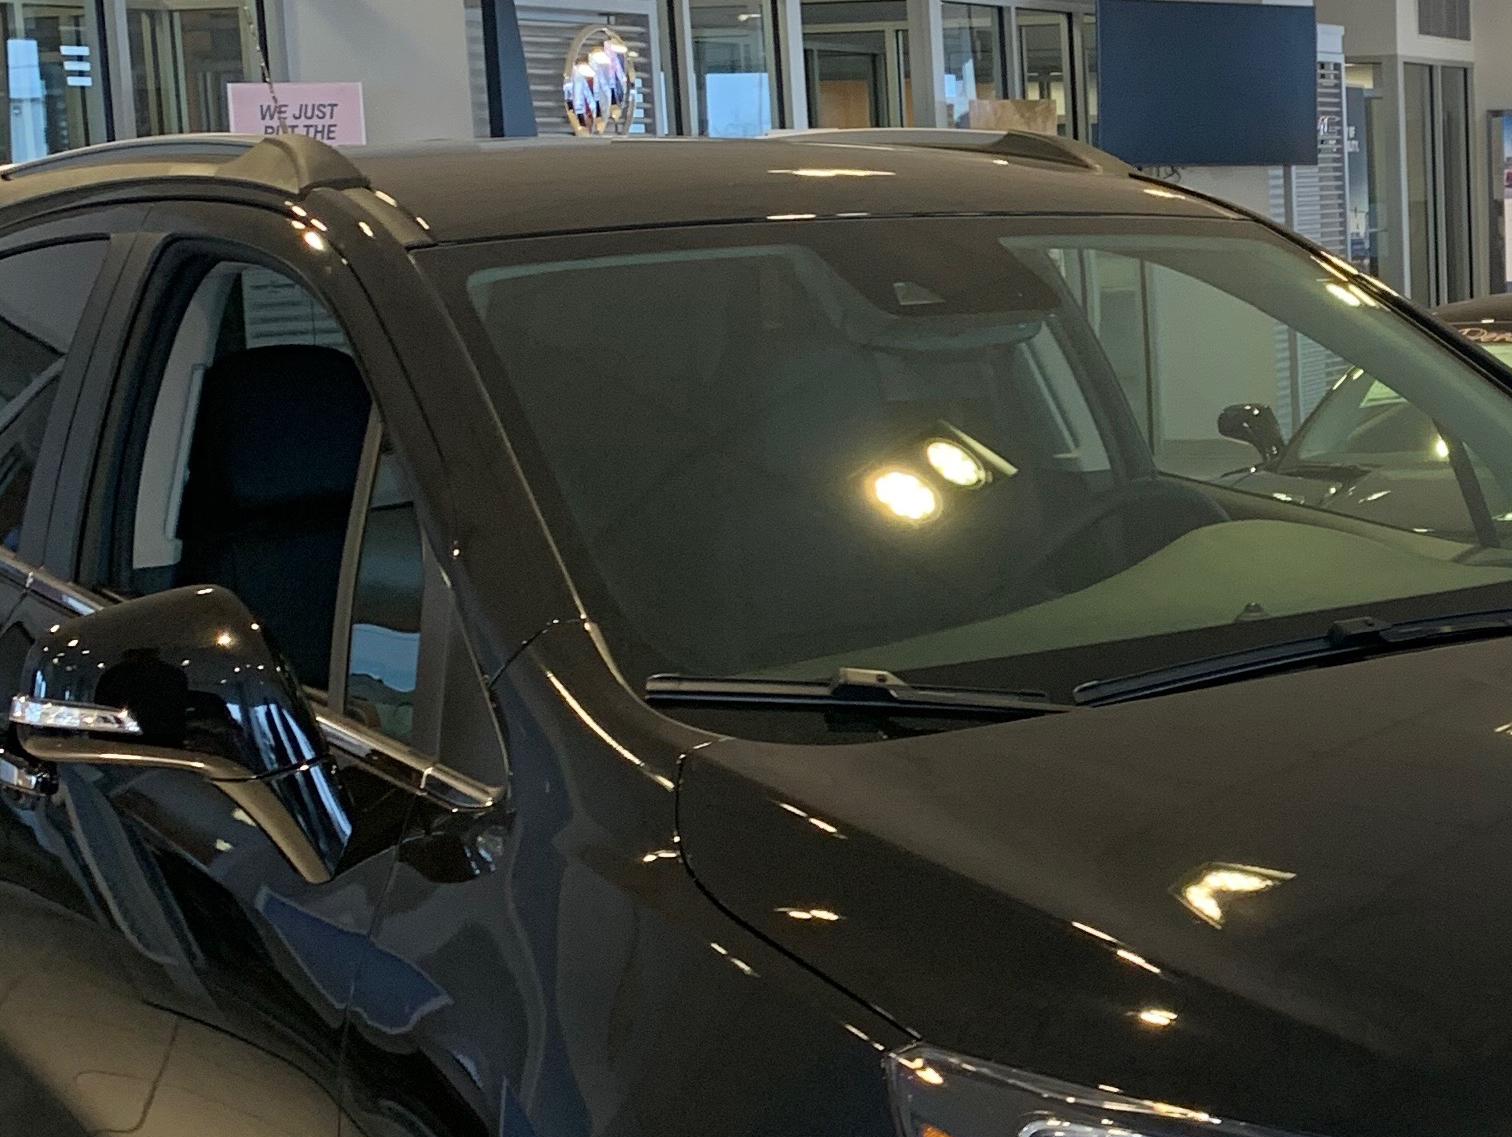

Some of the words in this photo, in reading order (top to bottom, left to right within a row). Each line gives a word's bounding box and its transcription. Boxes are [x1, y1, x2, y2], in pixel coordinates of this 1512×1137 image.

[259, 104, 289, 121] WE
[292, 103, 339, 120] JUST
[302, 124, 338, 140] THE
